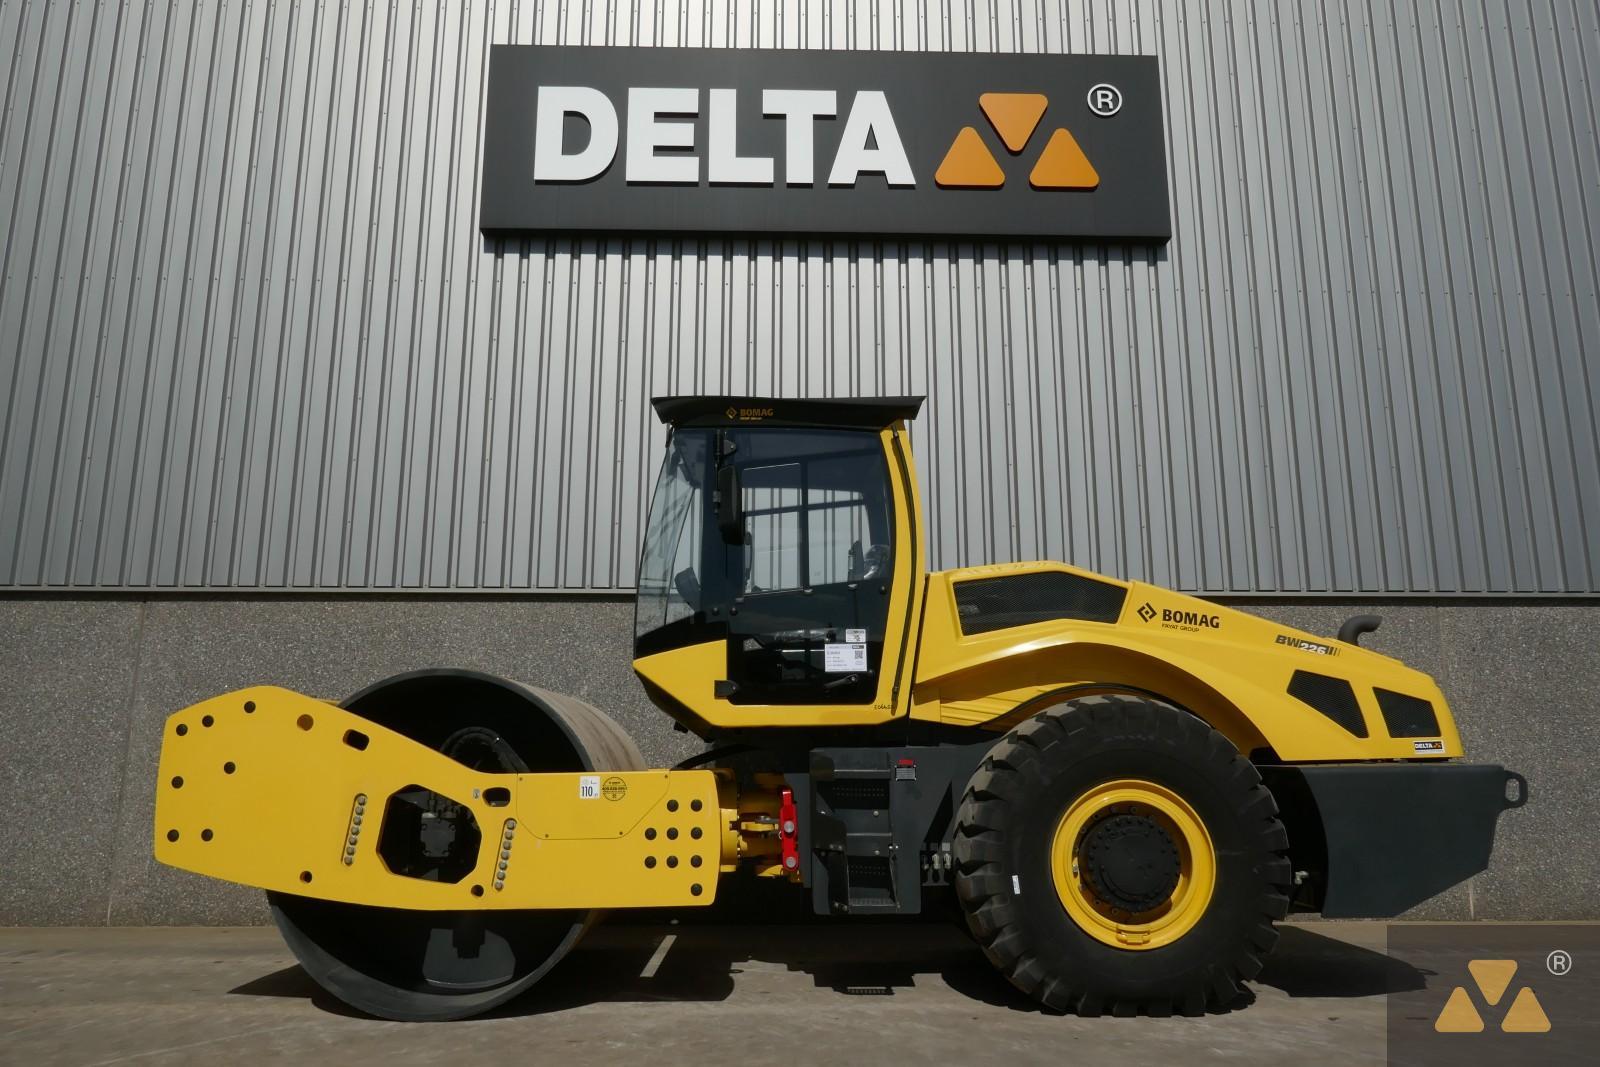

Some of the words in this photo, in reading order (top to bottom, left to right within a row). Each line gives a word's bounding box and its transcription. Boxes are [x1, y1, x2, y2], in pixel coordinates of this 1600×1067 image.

[533, 85, 917, 186] DELTA
[740, 408, 774, 417] BOMAG
[1162, 608, 1220, 629] BOMAG
[581, 785, 593, 797] 110
